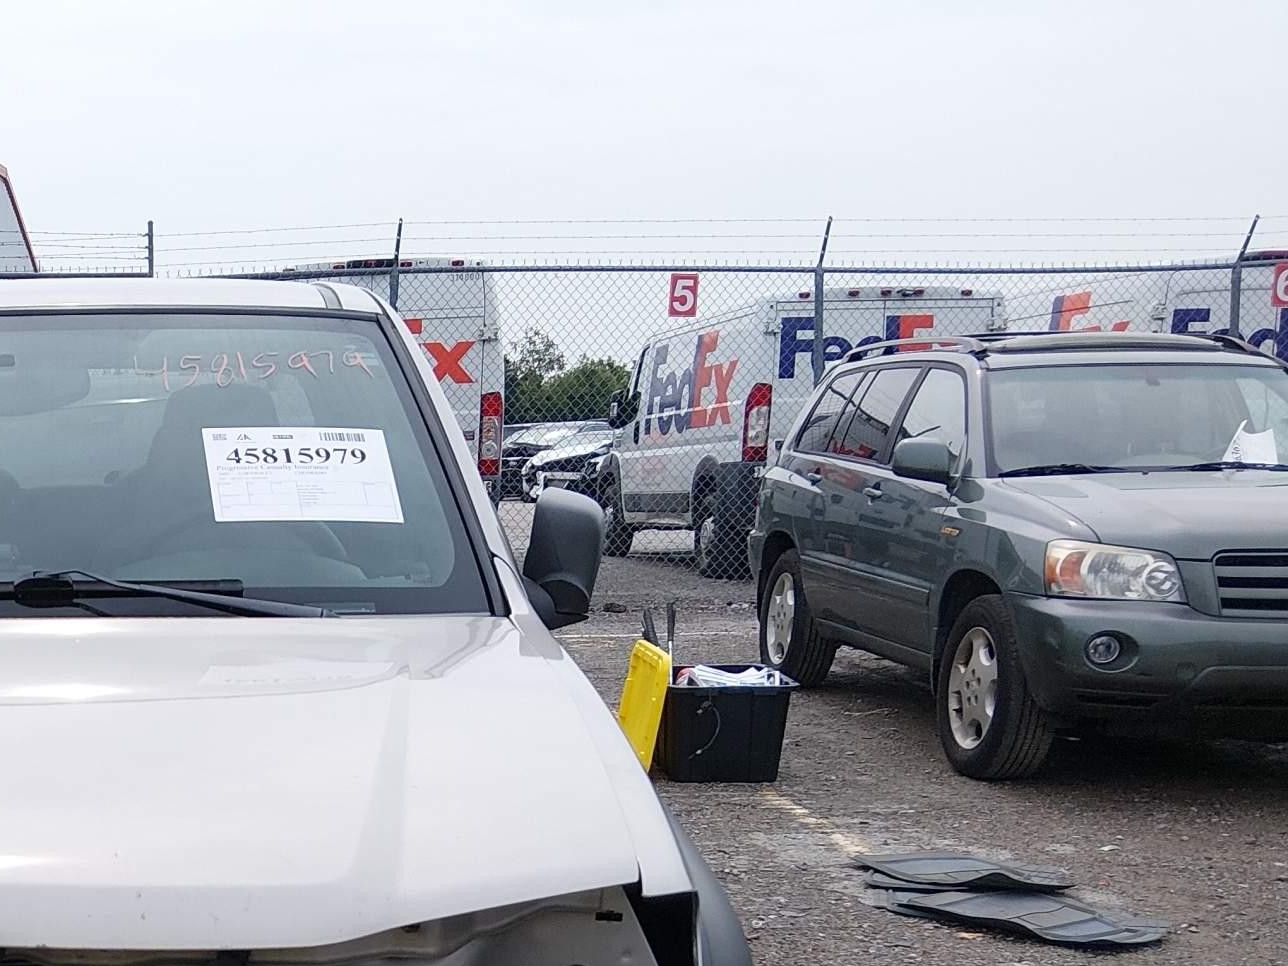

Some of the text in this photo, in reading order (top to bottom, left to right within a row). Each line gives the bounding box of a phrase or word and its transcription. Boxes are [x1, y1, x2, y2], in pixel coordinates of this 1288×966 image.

[672, 279, 695, 312] 5
[133, 351, 375, 392] 45815979
[644, 329, 738, 437] FedEx
[225, 447, 366, 465] 45815979
